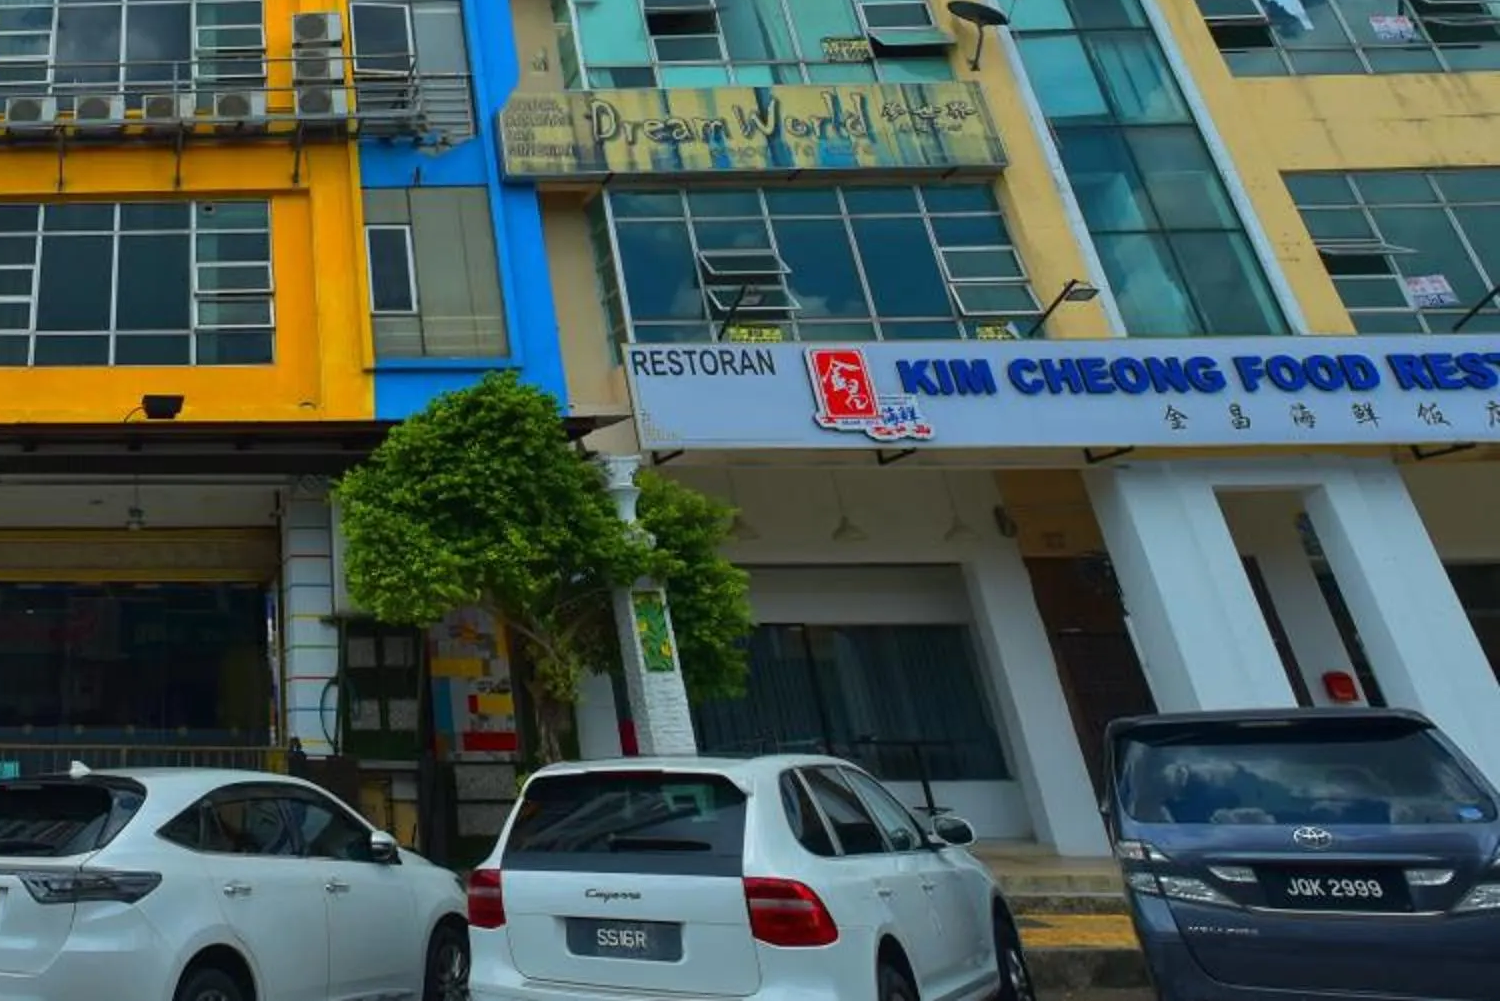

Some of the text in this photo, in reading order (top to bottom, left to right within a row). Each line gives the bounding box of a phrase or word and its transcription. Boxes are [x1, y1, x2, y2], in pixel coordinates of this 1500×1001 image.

[587, 90, 871, 145] Dream World
[631, 350, 776, 376] RESTORAN
[896, 358, 997, 395] KIM
[1008, 355, 1227, 395] CHEONG
[1232, 354, 1381, 393] FOOD
[1327, 879, 1383, 898] 2999
